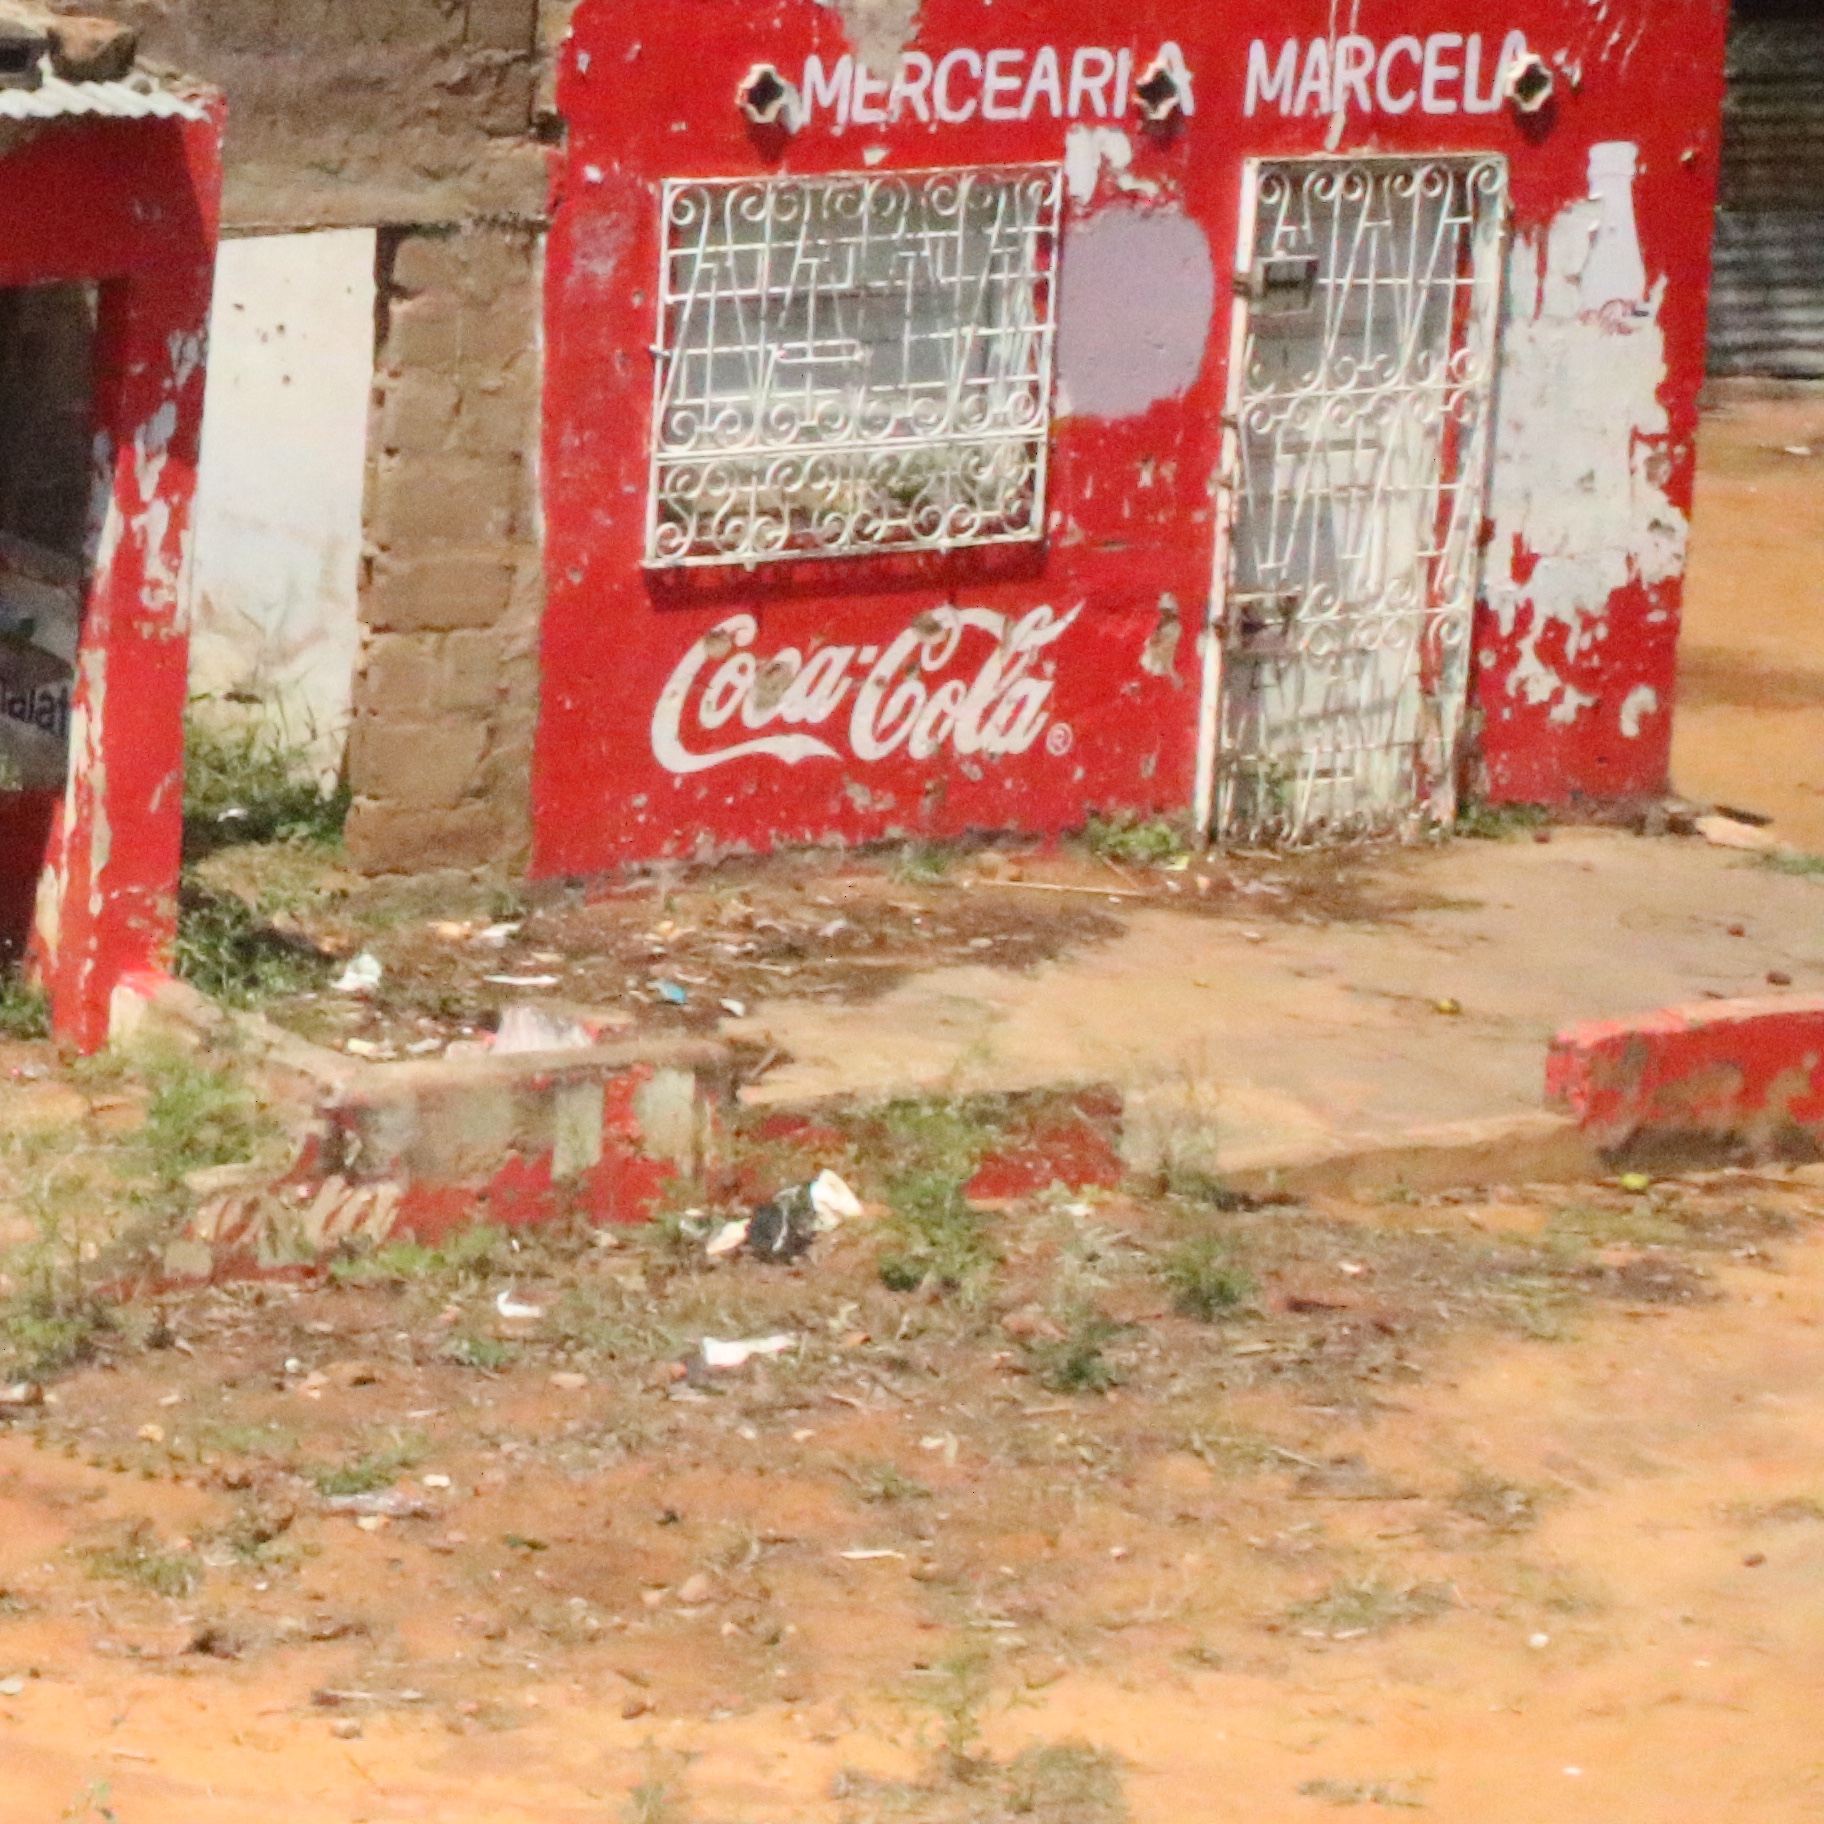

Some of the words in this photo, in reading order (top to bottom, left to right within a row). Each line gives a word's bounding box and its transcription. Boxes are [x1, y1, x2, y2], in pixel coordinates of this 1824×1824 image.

[800, 41, 1195, 124] MERCEARIA
[1243, 29, 1530, 117] MARCELA
[652, 600, 1086, 773] Coca-Cola
